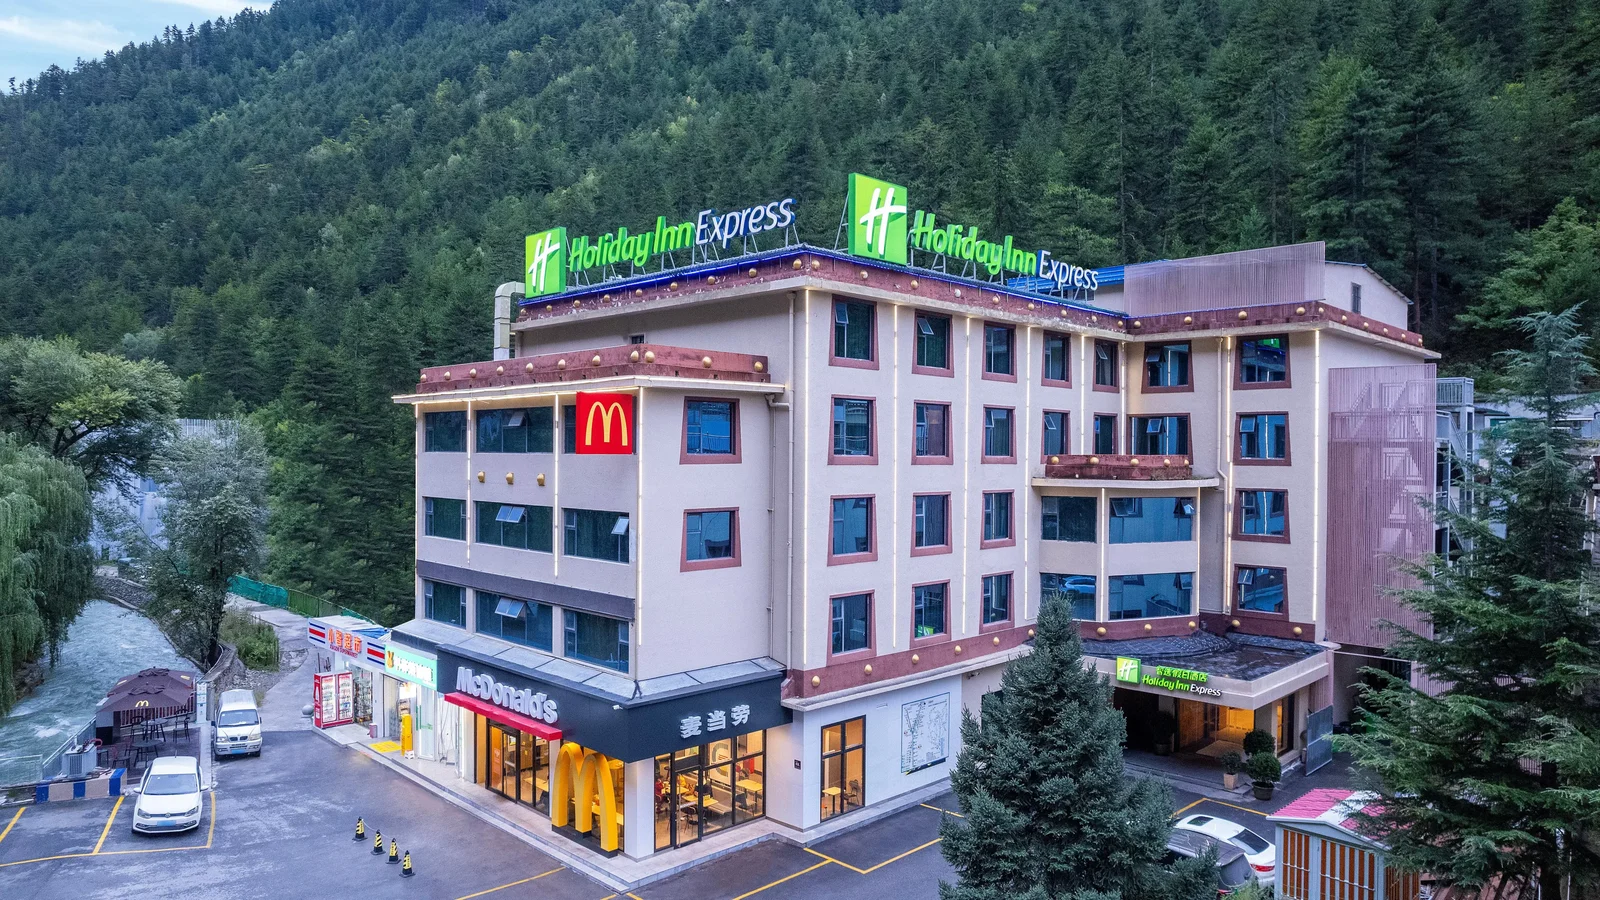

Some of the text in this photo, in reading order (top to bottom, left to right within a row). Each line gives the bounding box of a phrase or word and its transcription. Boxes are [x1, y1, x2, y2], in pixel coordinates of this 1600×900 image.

[569, 198, 797, 272] Holiday Inn Express
[910, 210, 1099, 291] Holiday Inn Express
[456, 666, 558, 724] McDonald's
[1142, 674, 1221, 697] Holiday Inn Express
[680, 704, 750, 739] 麦当劳
